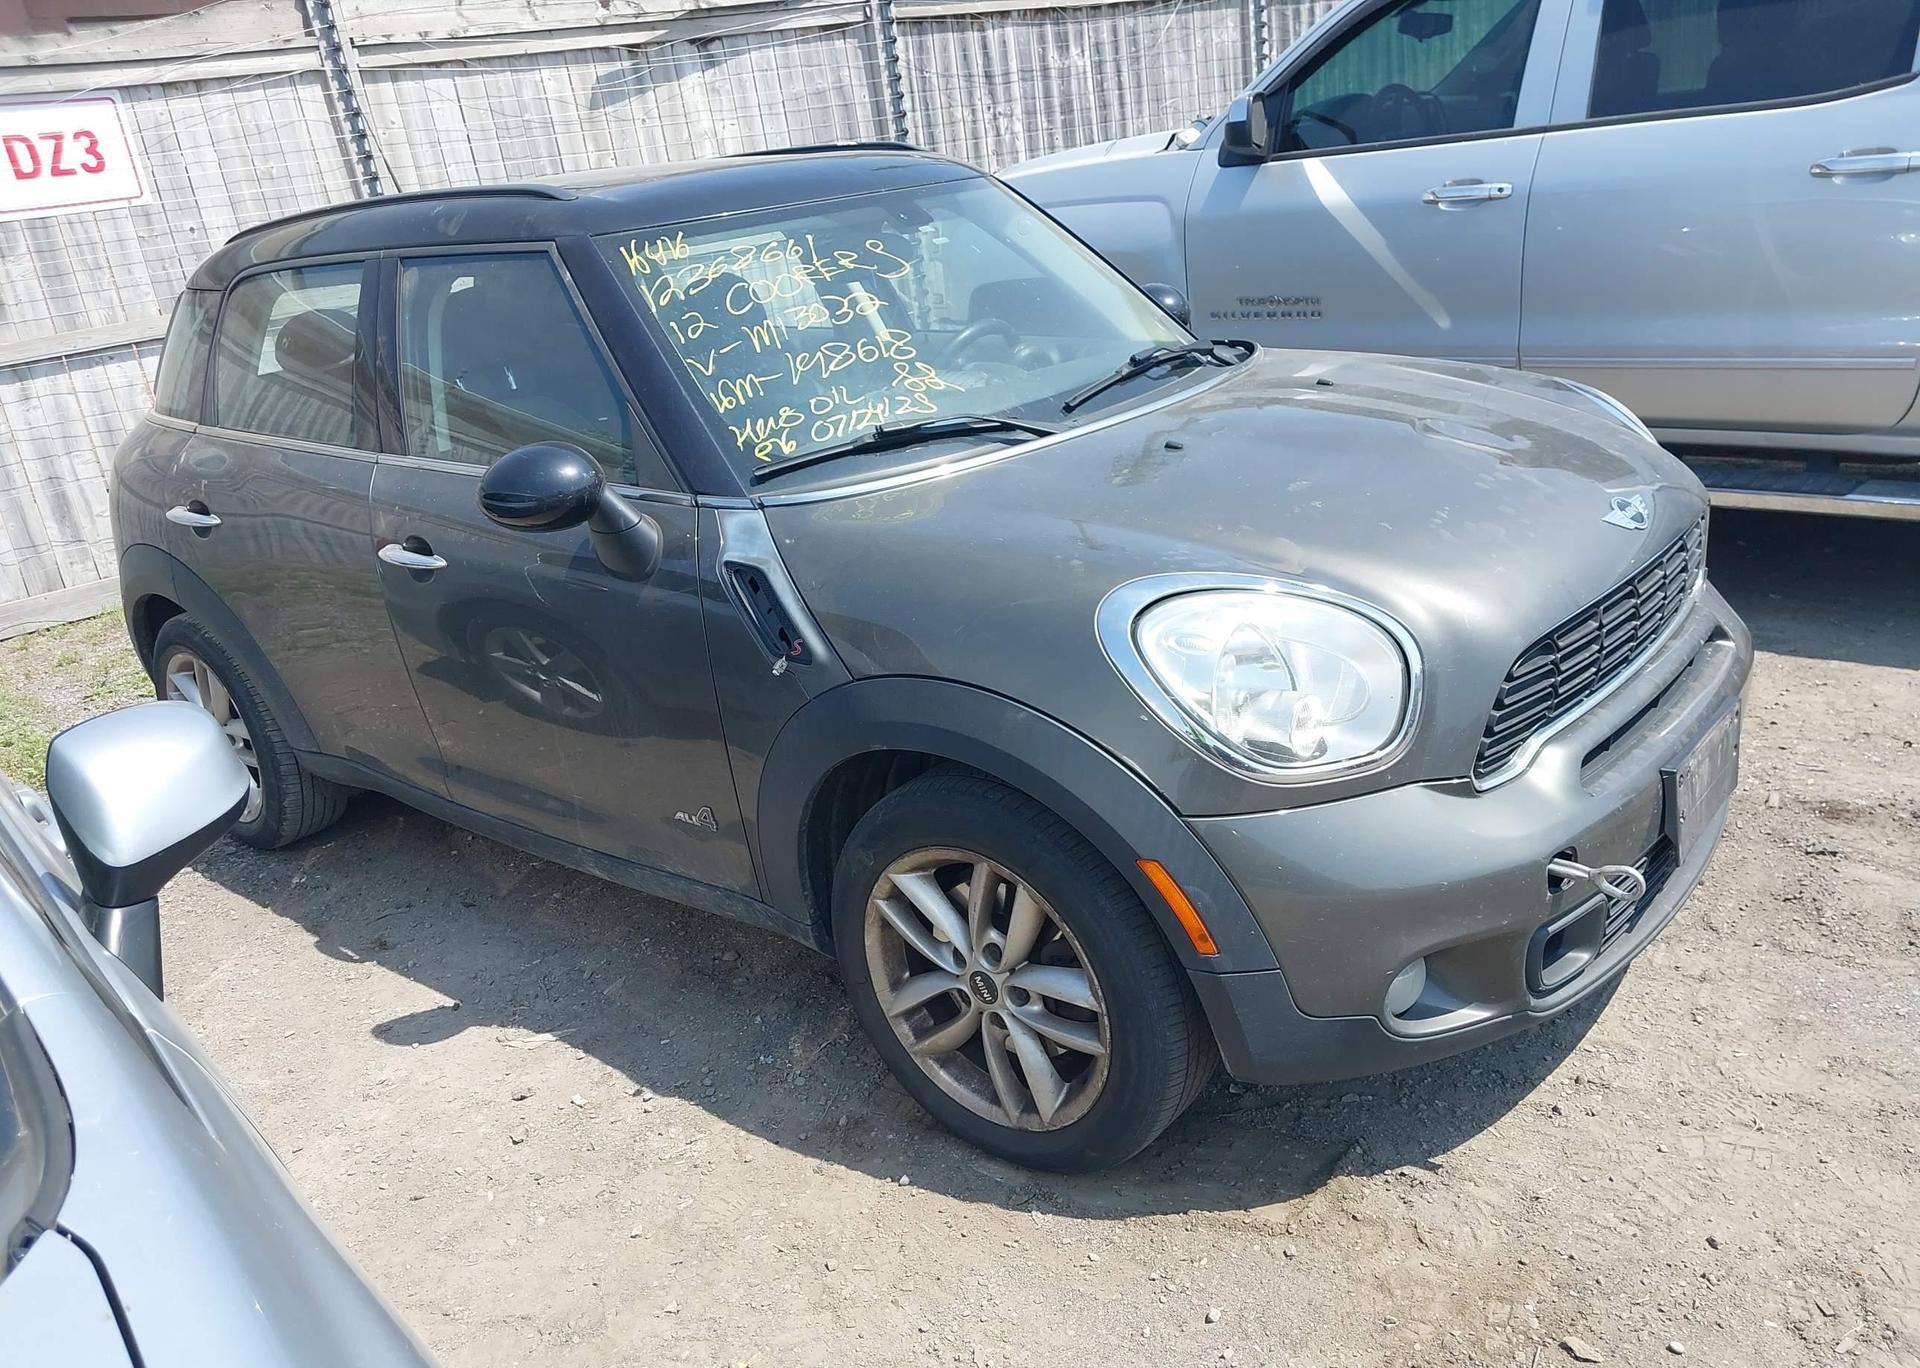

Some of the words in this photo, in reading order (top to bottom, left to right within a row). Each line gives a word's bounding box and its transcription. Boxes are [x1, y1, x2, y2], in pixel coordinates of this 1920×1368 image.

[2, 129, 106, 180] DZ3
[1209, 310, 1321, 320] SILVERADO
[974, 975, 993, 1001] MINI
